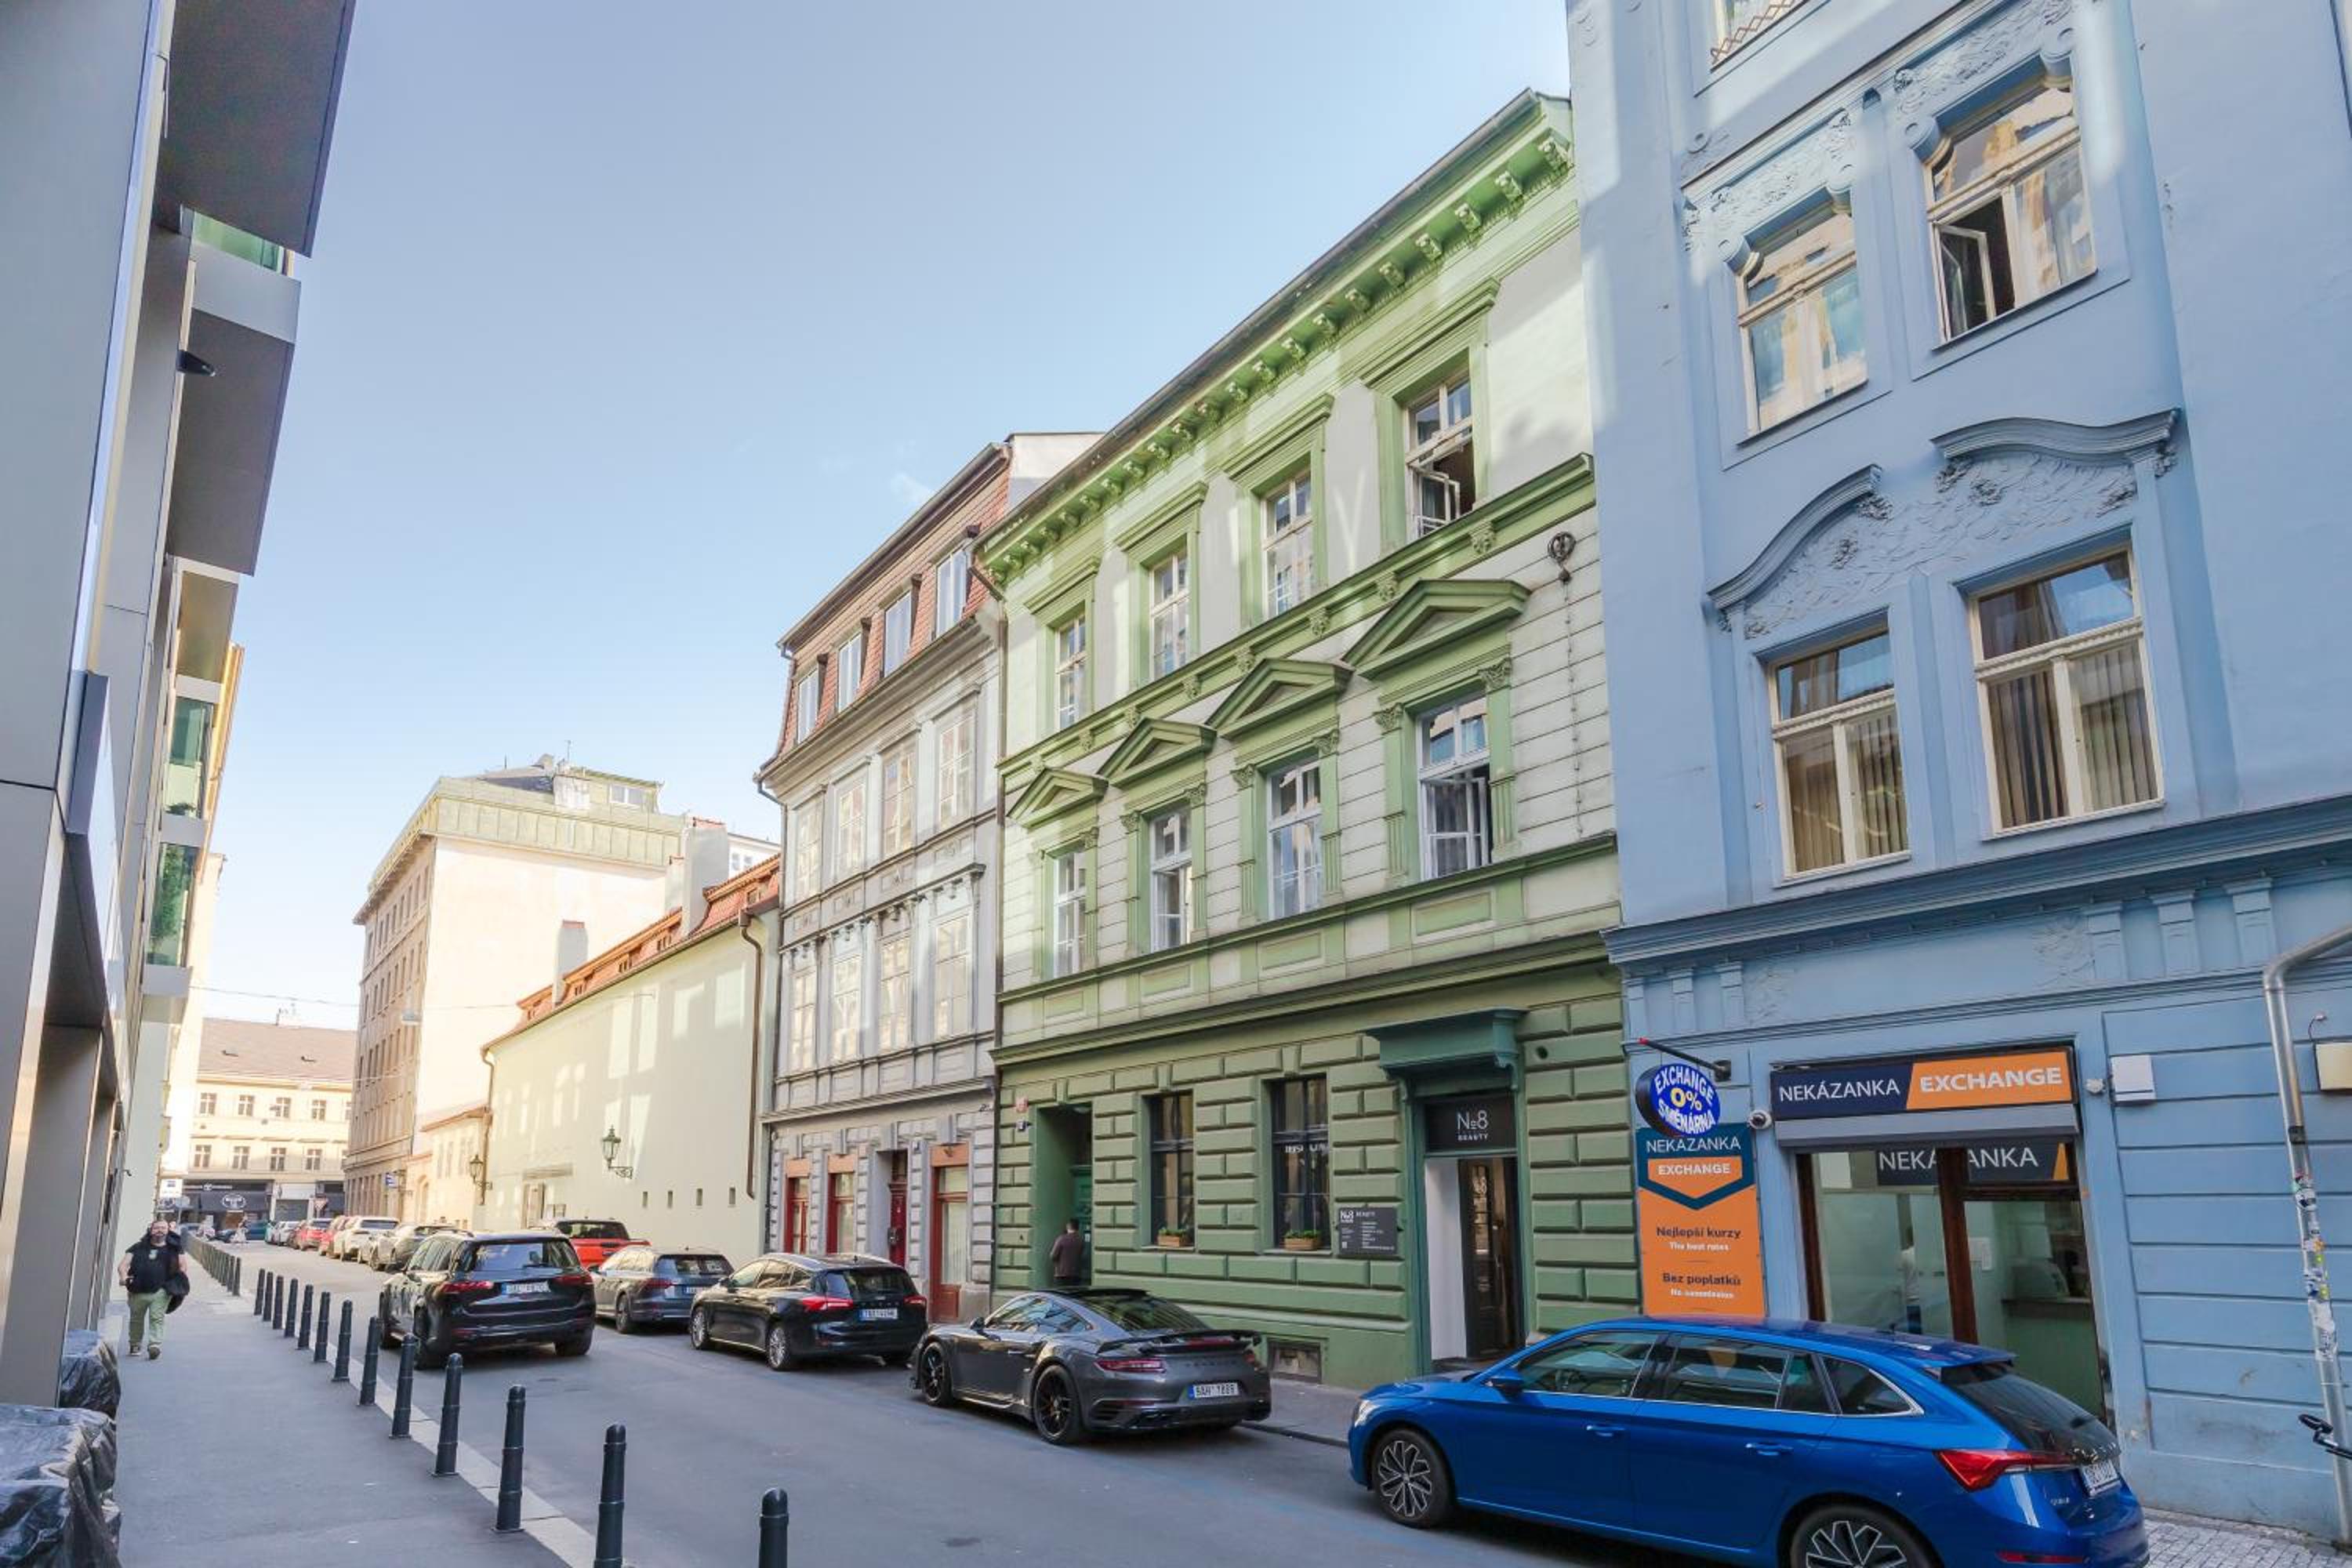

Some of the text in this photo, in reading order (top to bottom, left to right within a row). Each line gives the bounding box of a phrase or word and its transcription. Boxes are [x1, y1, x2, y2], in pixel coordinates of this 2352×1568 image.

[1654, 1065, 1714, 1106] EXCHANGE
[1779, 1067, 2063, 1102] NEKÁZANKA EXCHANGE
[1670, 1087, 1703, 1111] 0%
[1657, 1163, 1731, 1175] EXCHANGE
[1707, 1227, 1740, 1239] kurzy
[1662, 1272, 1684, 1283] Bez
